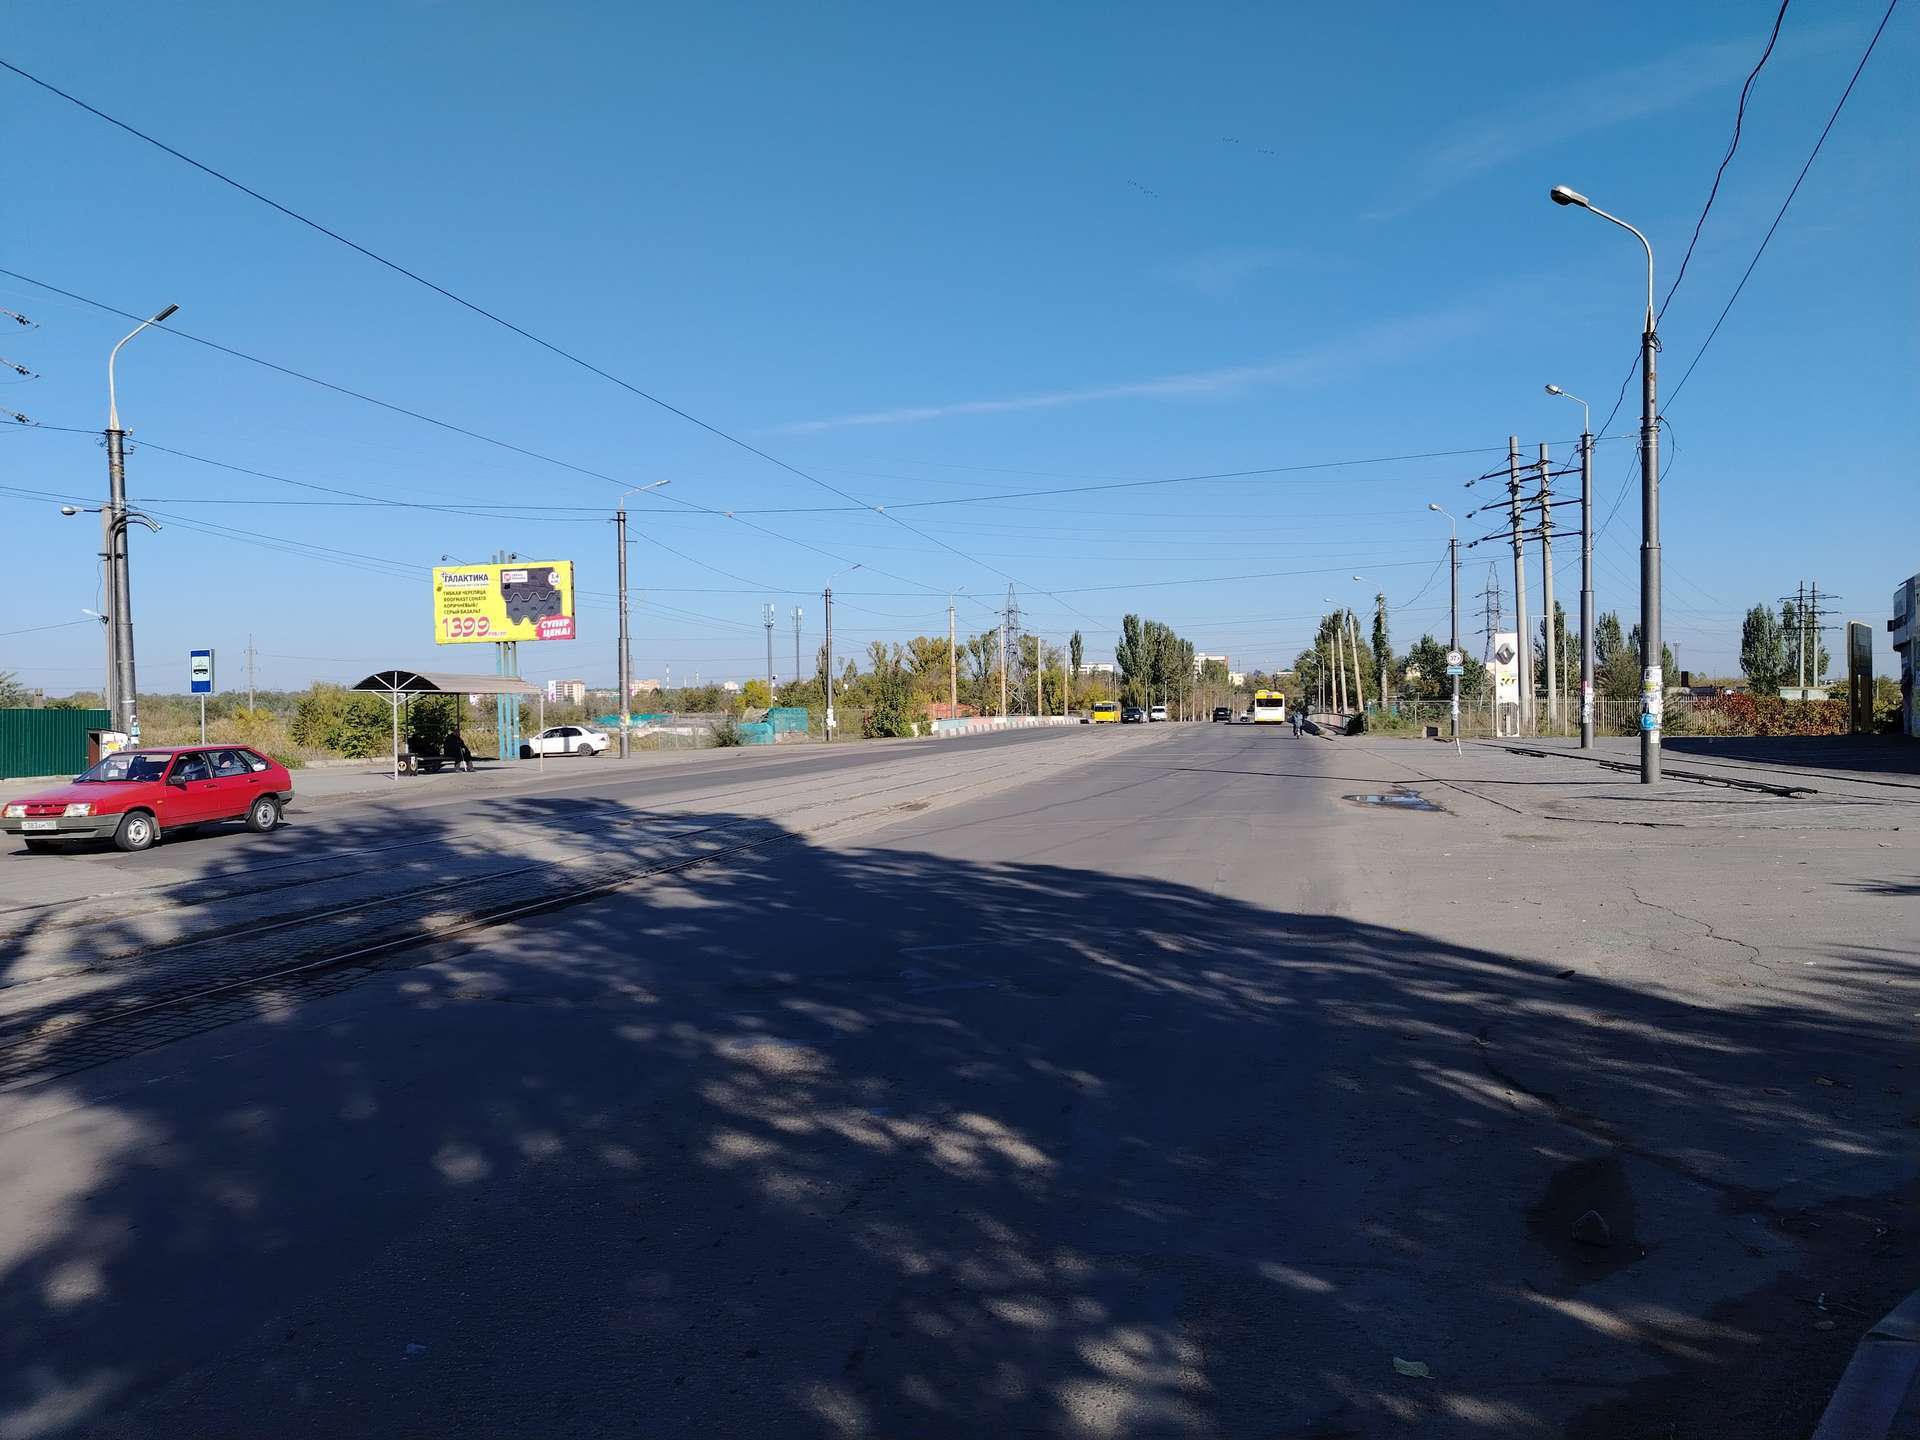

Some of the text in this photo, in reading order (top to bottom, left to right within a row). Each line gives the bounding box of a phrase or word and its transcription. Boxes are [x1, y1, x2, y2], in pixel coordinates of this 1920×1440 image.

[445, 574, 489, 582] ГАЛАКТИКА
[442, 616, 490, 637] 1399
[542, 619, 570, 628] СУПЕР
[543, 628, 571, 638] ЦЕНА!
